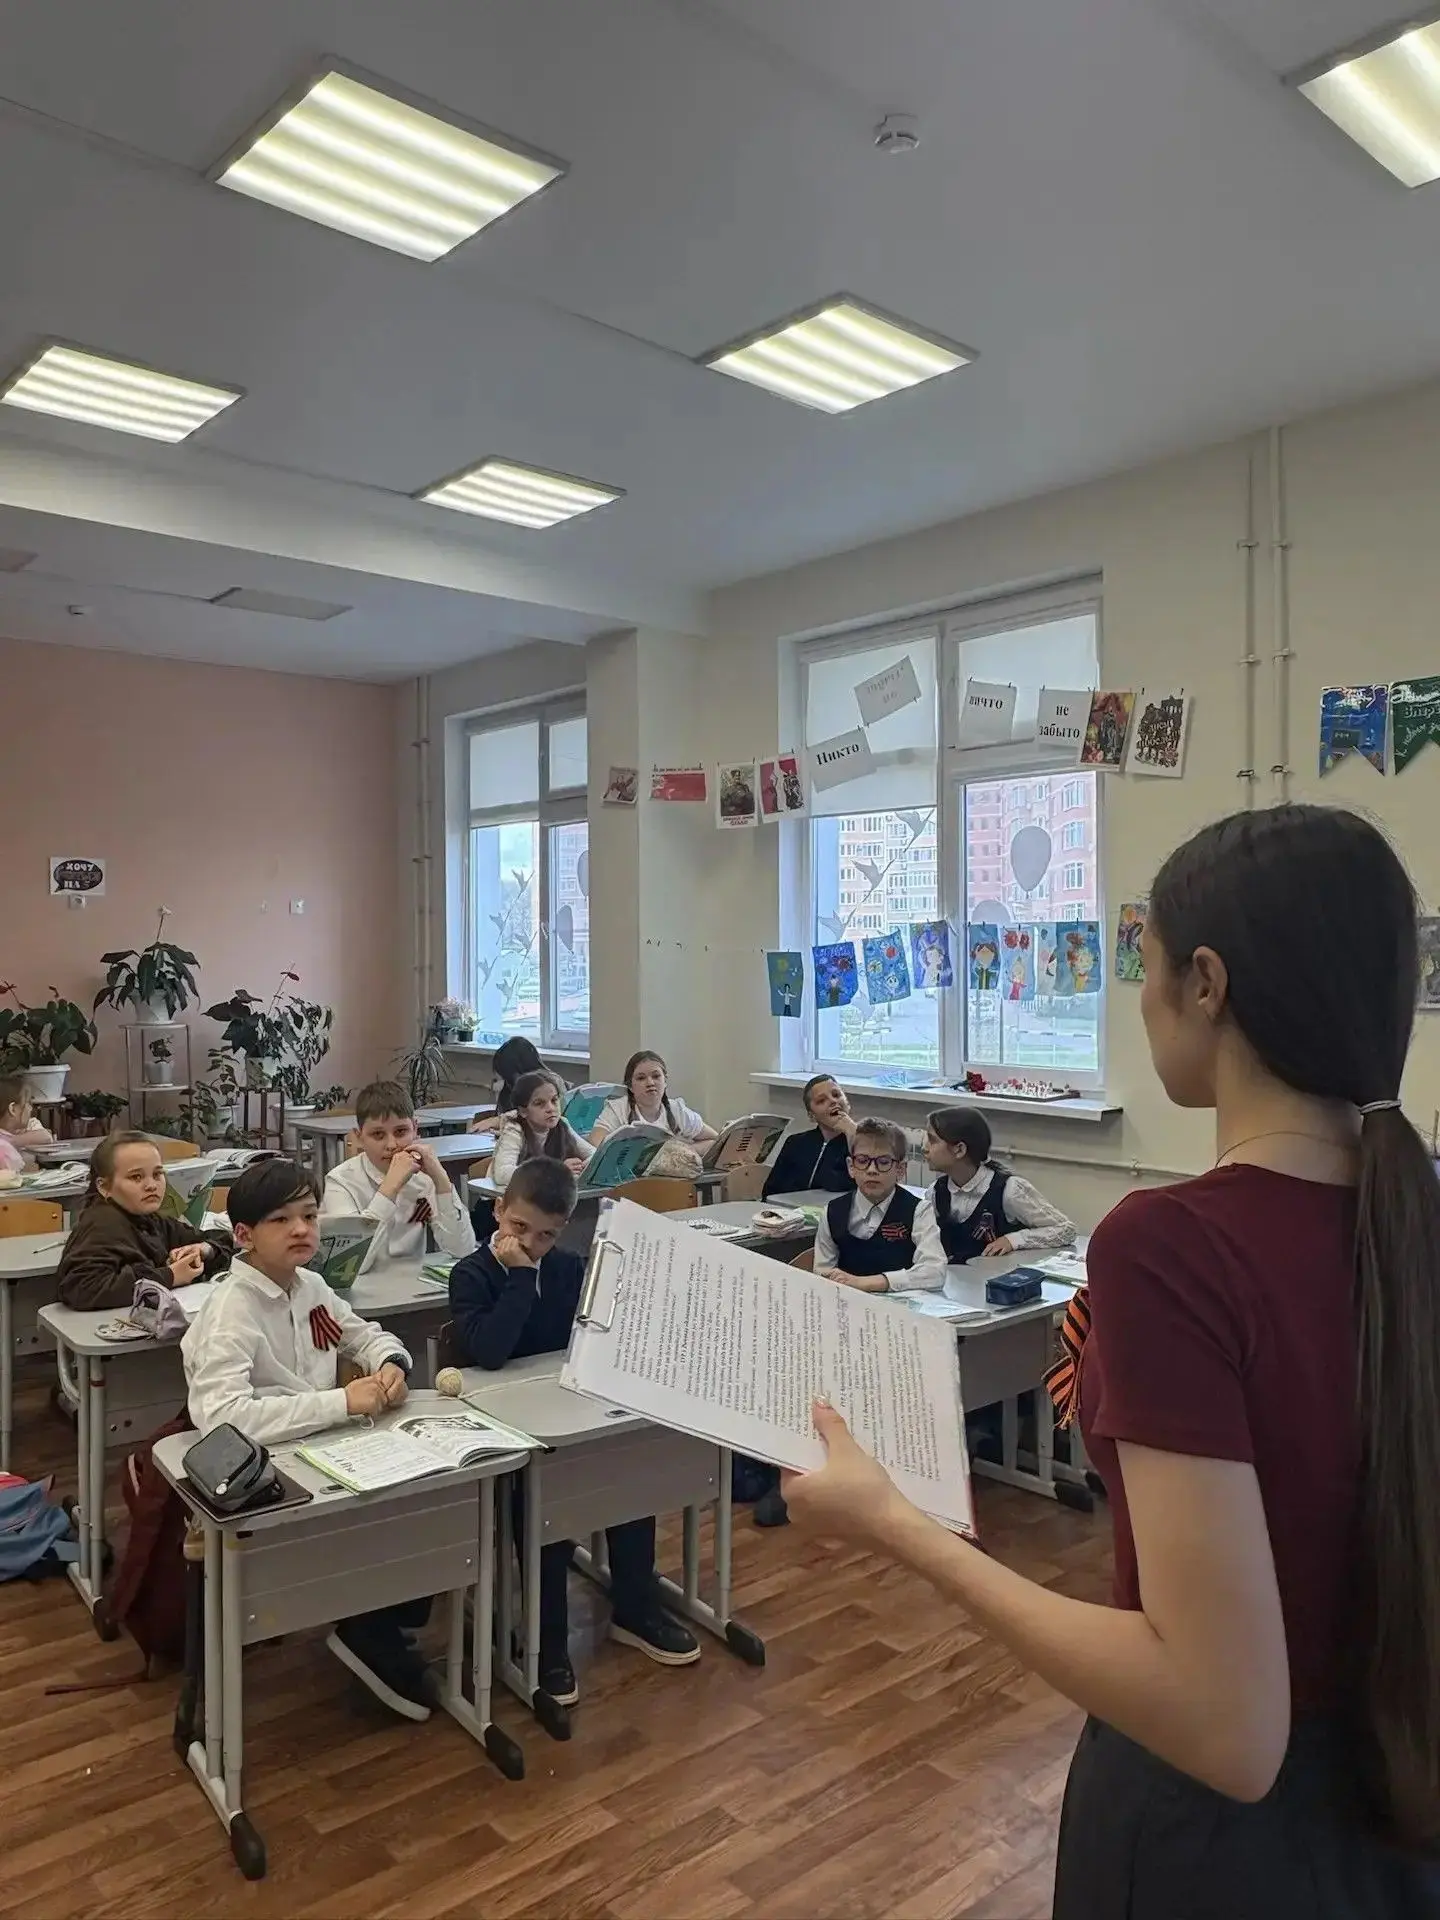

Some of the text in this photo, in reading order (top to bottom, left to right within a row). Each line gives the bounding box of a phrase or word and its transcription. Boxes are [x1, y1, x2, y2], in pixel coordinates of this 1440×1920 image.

[1056, 704, 1069, 716] не
[1039, 723, 1080, 739] забыто
[816, 744, 859, 765] Никто
[330, 1253, 361, 1281] 4
